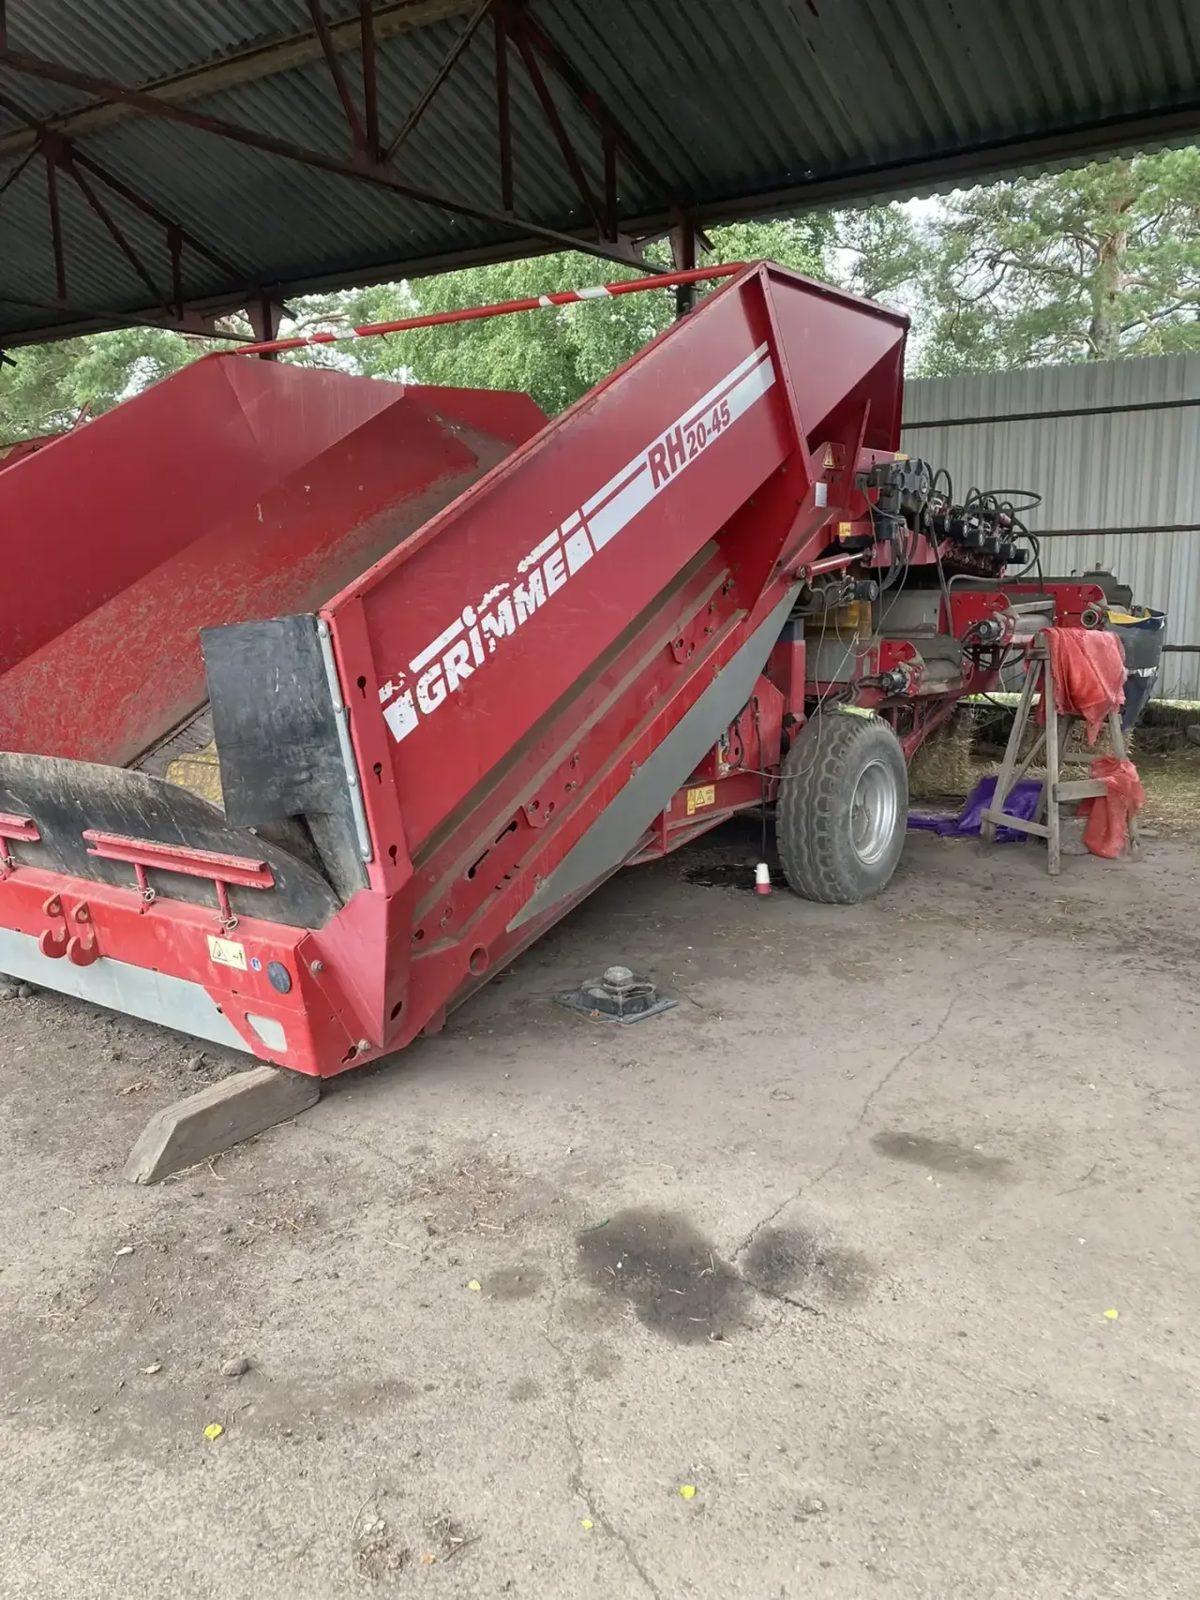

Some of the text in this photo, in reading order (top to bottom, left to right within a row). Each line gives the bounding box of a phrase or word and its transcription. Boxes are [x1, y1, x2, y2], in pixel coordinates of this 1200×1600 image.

[648, 399, 731, 490] RH 20-45
[416, 546, 568, 715] GRIMME
